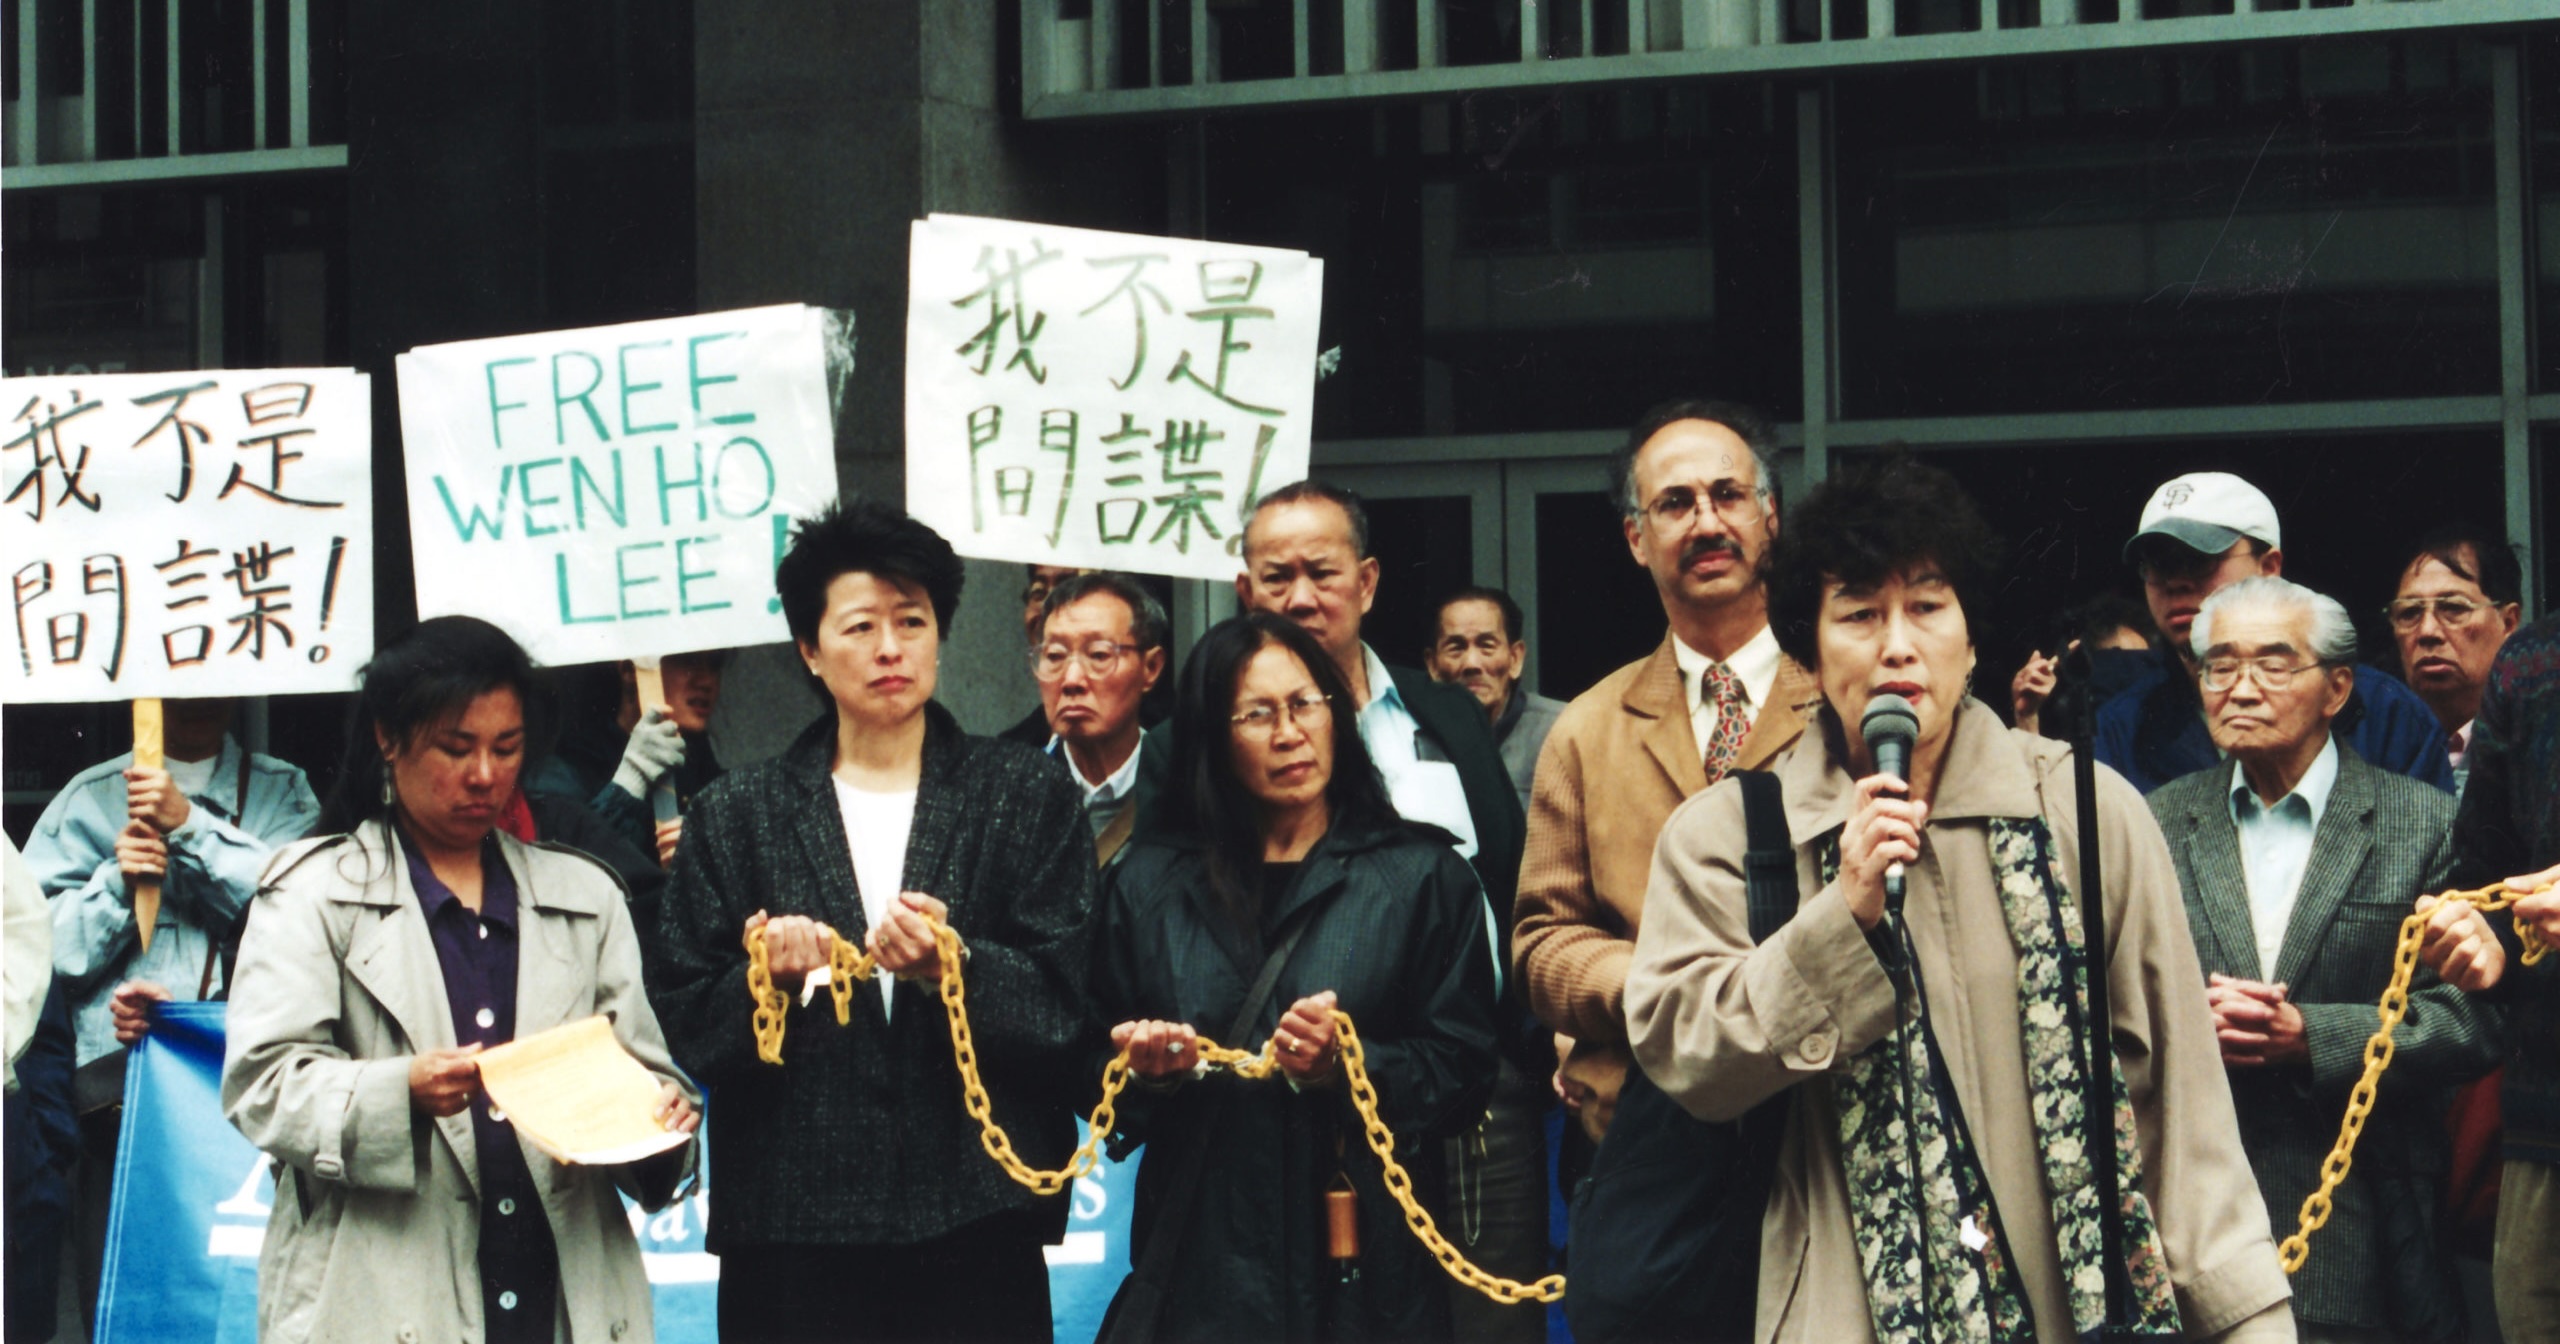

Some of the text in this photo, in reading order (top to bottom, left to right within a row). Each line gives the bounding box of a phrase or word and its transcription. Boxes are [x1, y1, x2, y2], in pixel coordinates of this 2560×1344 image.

[485, 332, 757, 449] FREE
[951, 240, 1287, 416] 我不是
[2, 381, 346, 523] 我不是
[432, 435, 777, 543] WEN HO
[968, 405, 1278, 556] 間諜!
[12, 536, 349, 682] 間諜!
